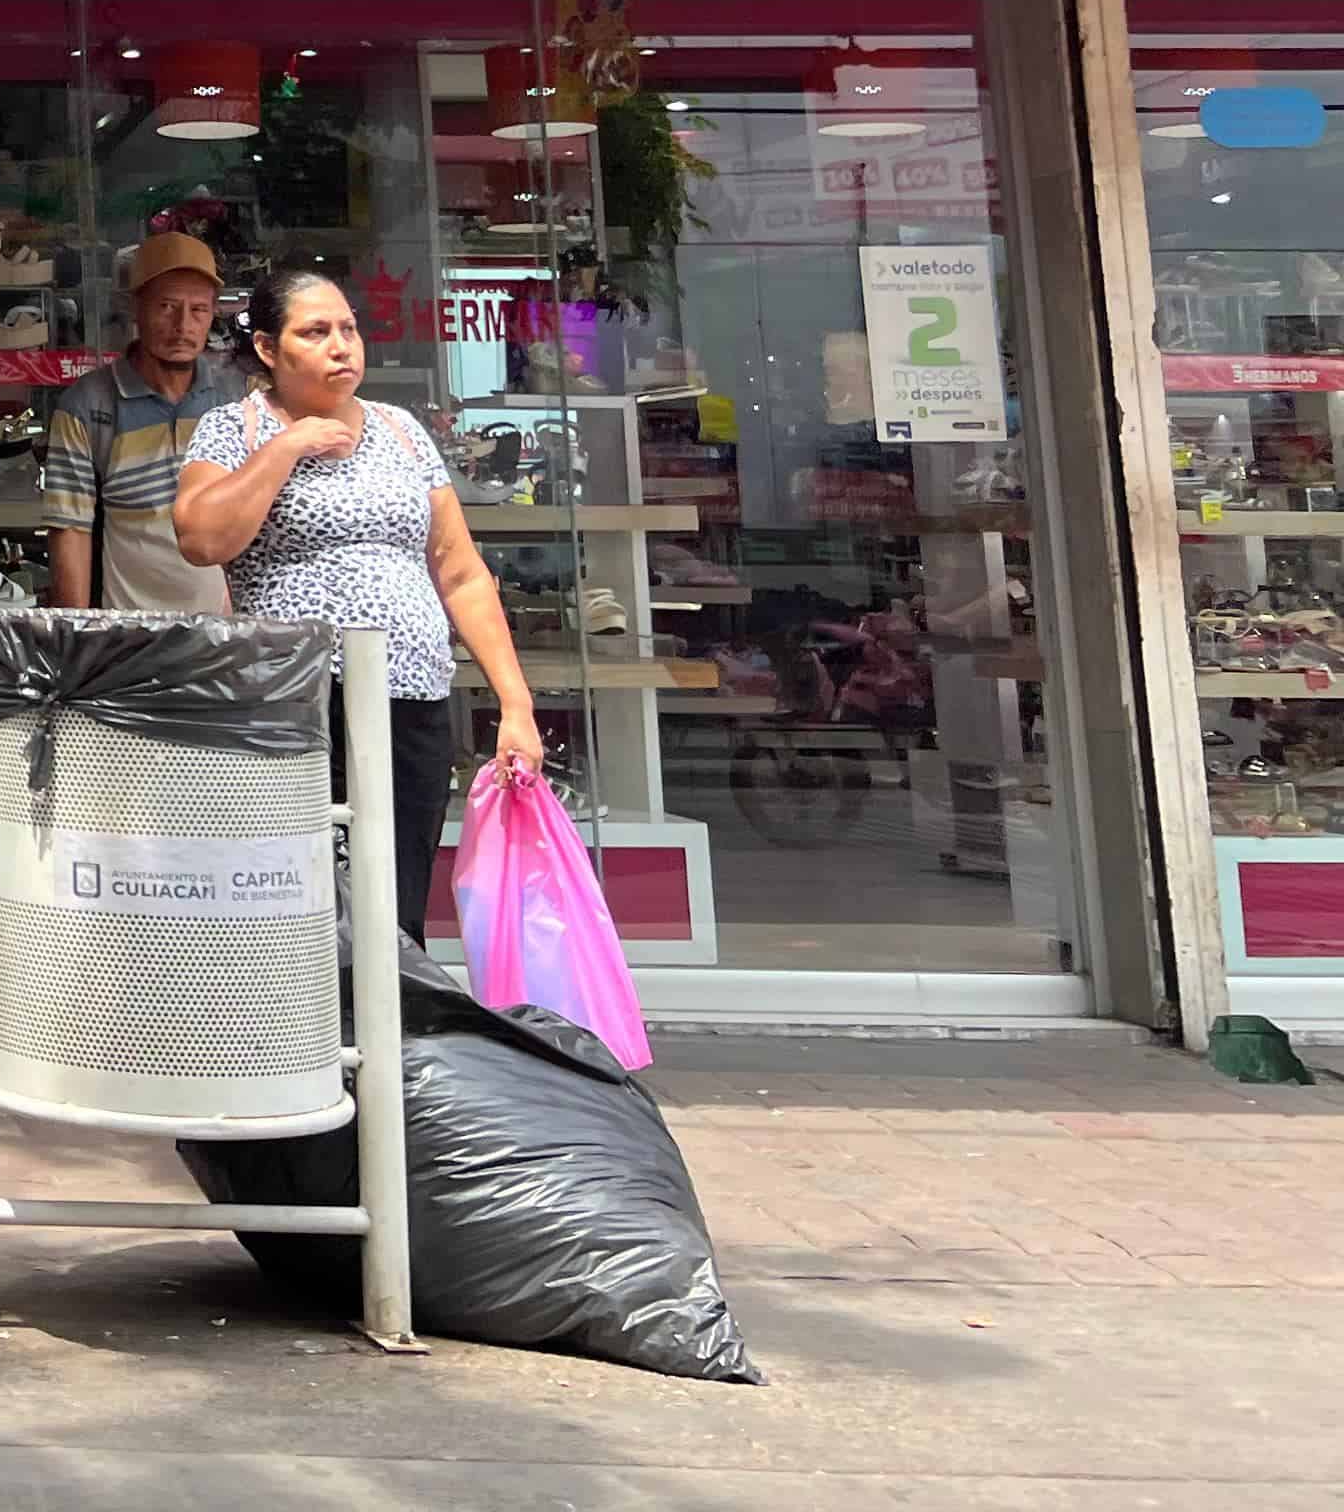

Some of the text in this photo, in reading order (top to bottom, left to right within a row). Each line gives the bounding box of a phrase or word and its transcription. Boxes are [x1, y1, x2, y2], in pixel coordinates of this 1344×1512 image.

[891, 260, 976, 276] valetodo
[908, 296, 961, 367] 2
[892, 367, 983, 388] meses
[111, 869, 215, 883] AYUNTAMIENTO DE
[232, 871, 303, 888] CAPITAL
[231, 890, 248, 901] DE
